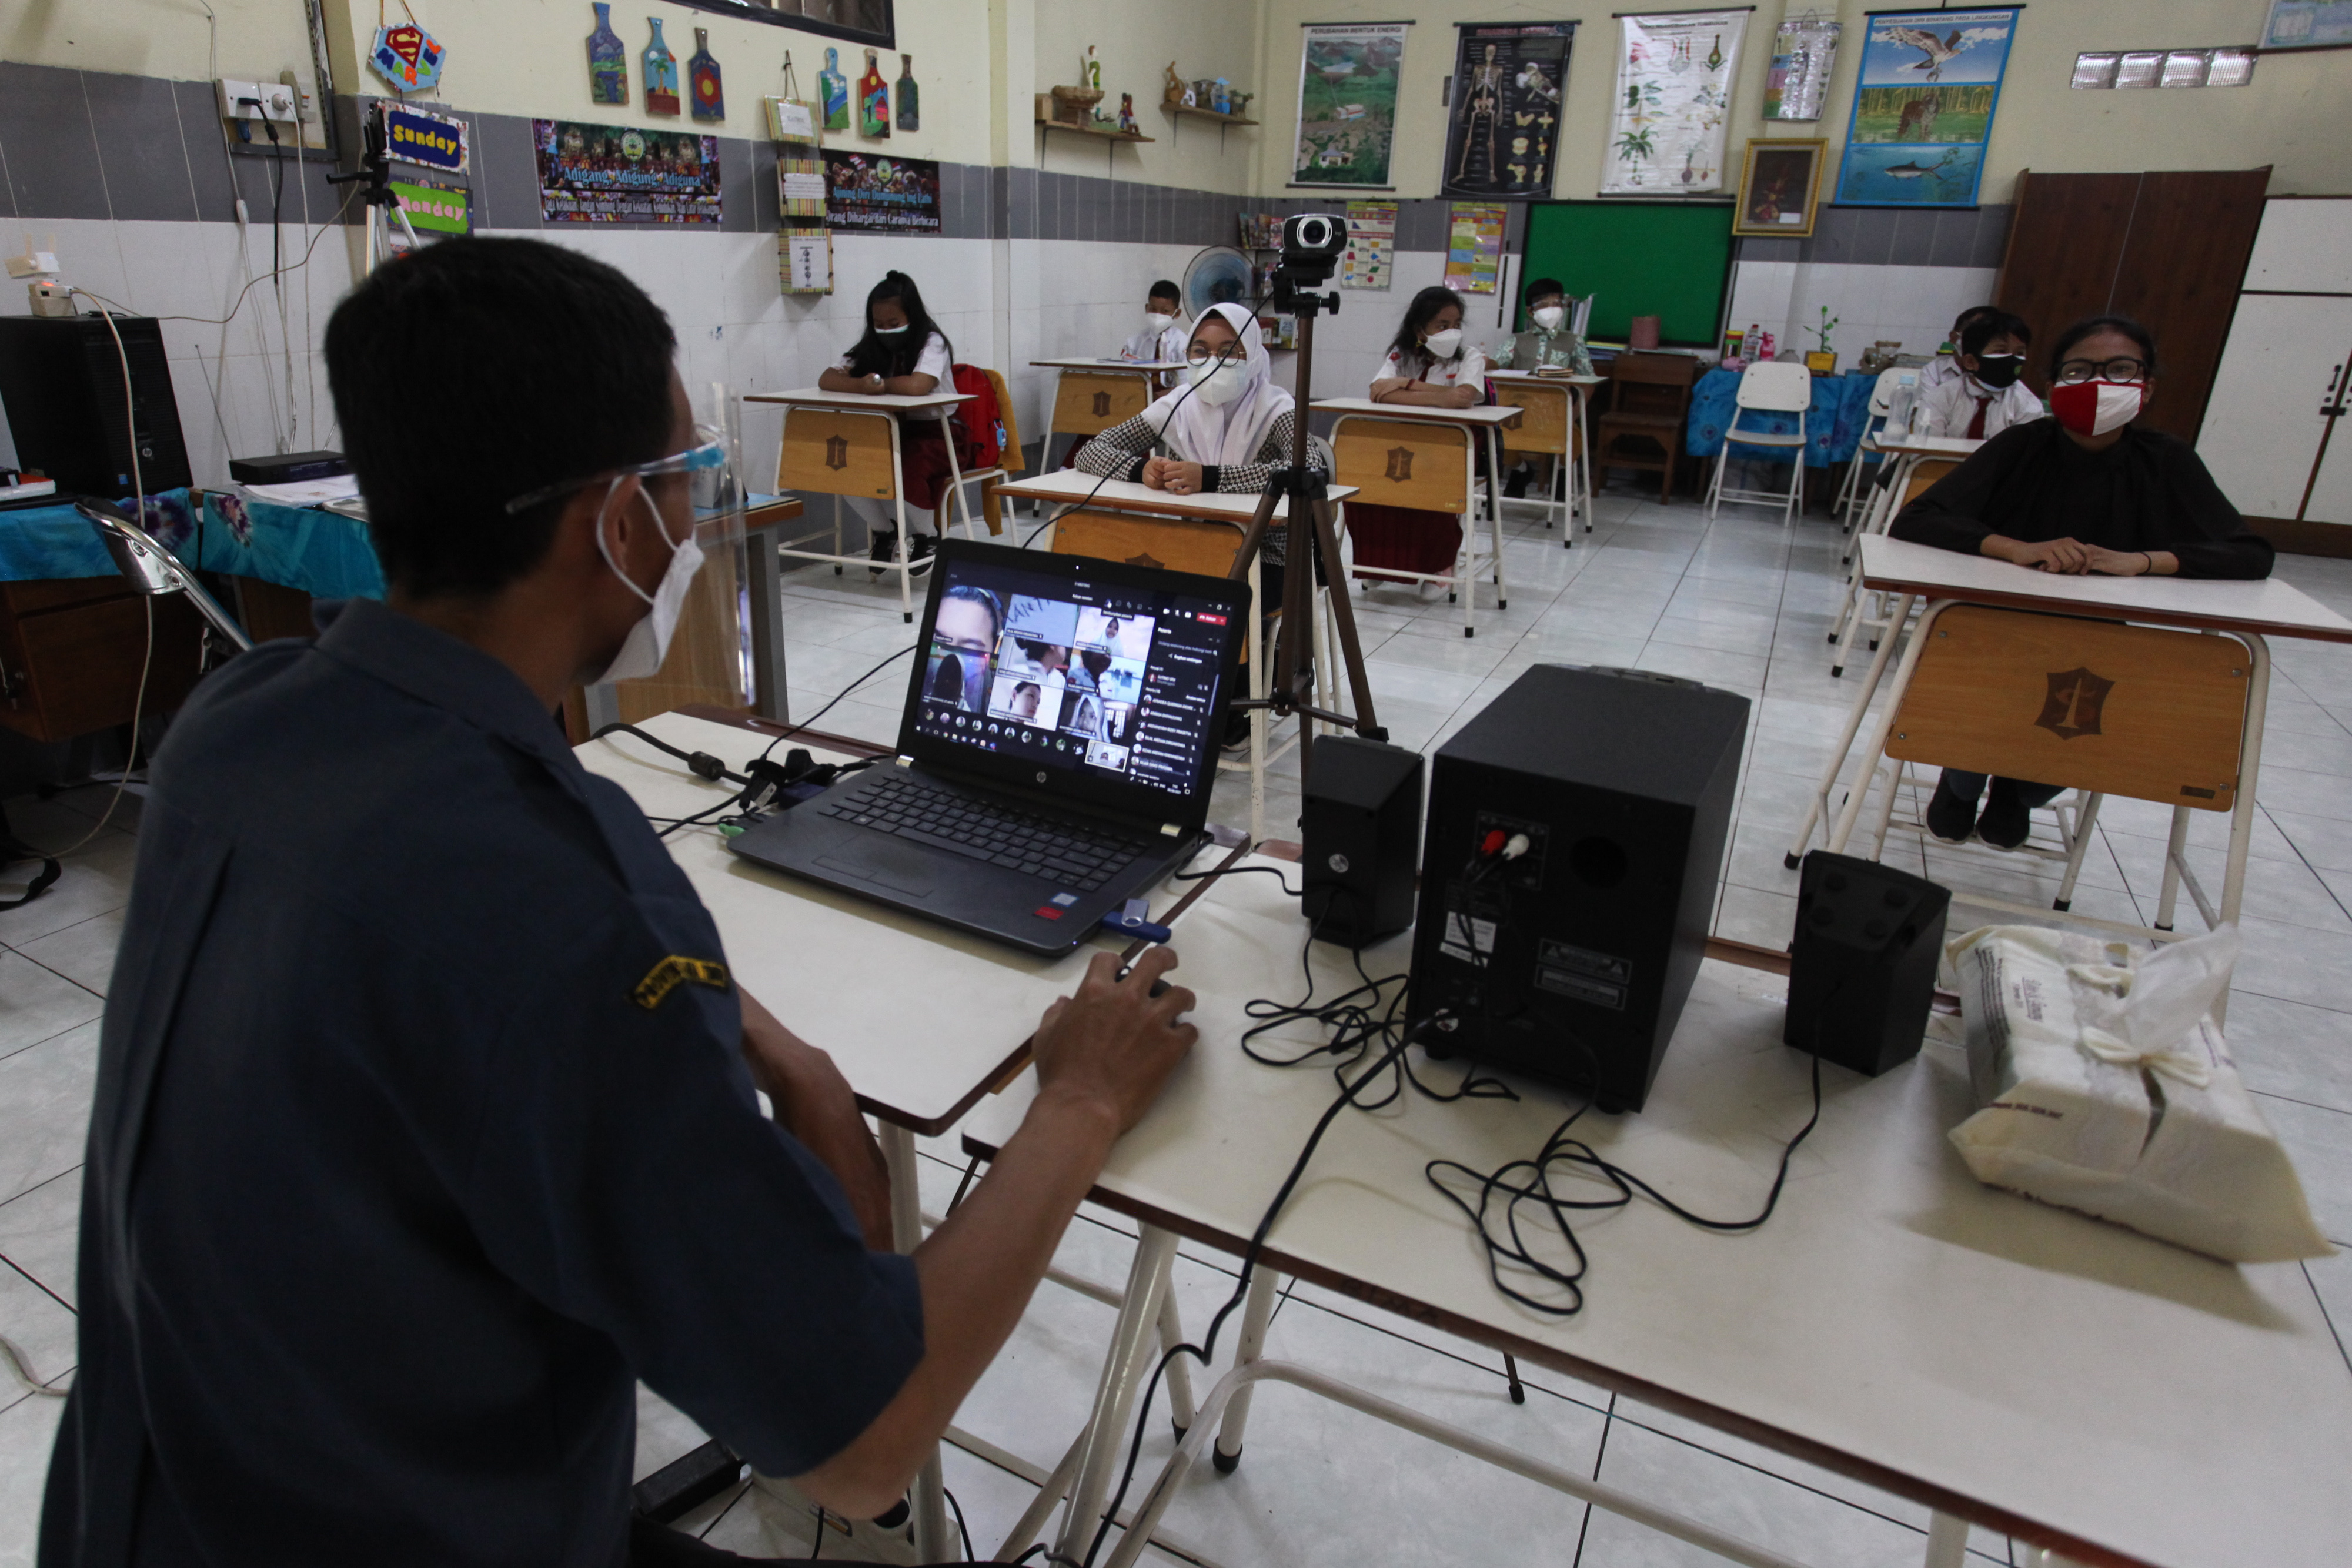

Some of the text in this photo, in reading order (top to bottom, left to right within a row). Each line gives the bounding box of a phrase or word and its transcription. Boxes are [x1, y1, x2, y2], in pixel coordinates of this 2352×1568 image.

[377, 39, 441, 85] MARVEL
[393, 124, 457, 155] Sunday
[564, 166, 701, 188] Adigang, Adigung, Adiguna
[395, 194, 464, 222] Monday
